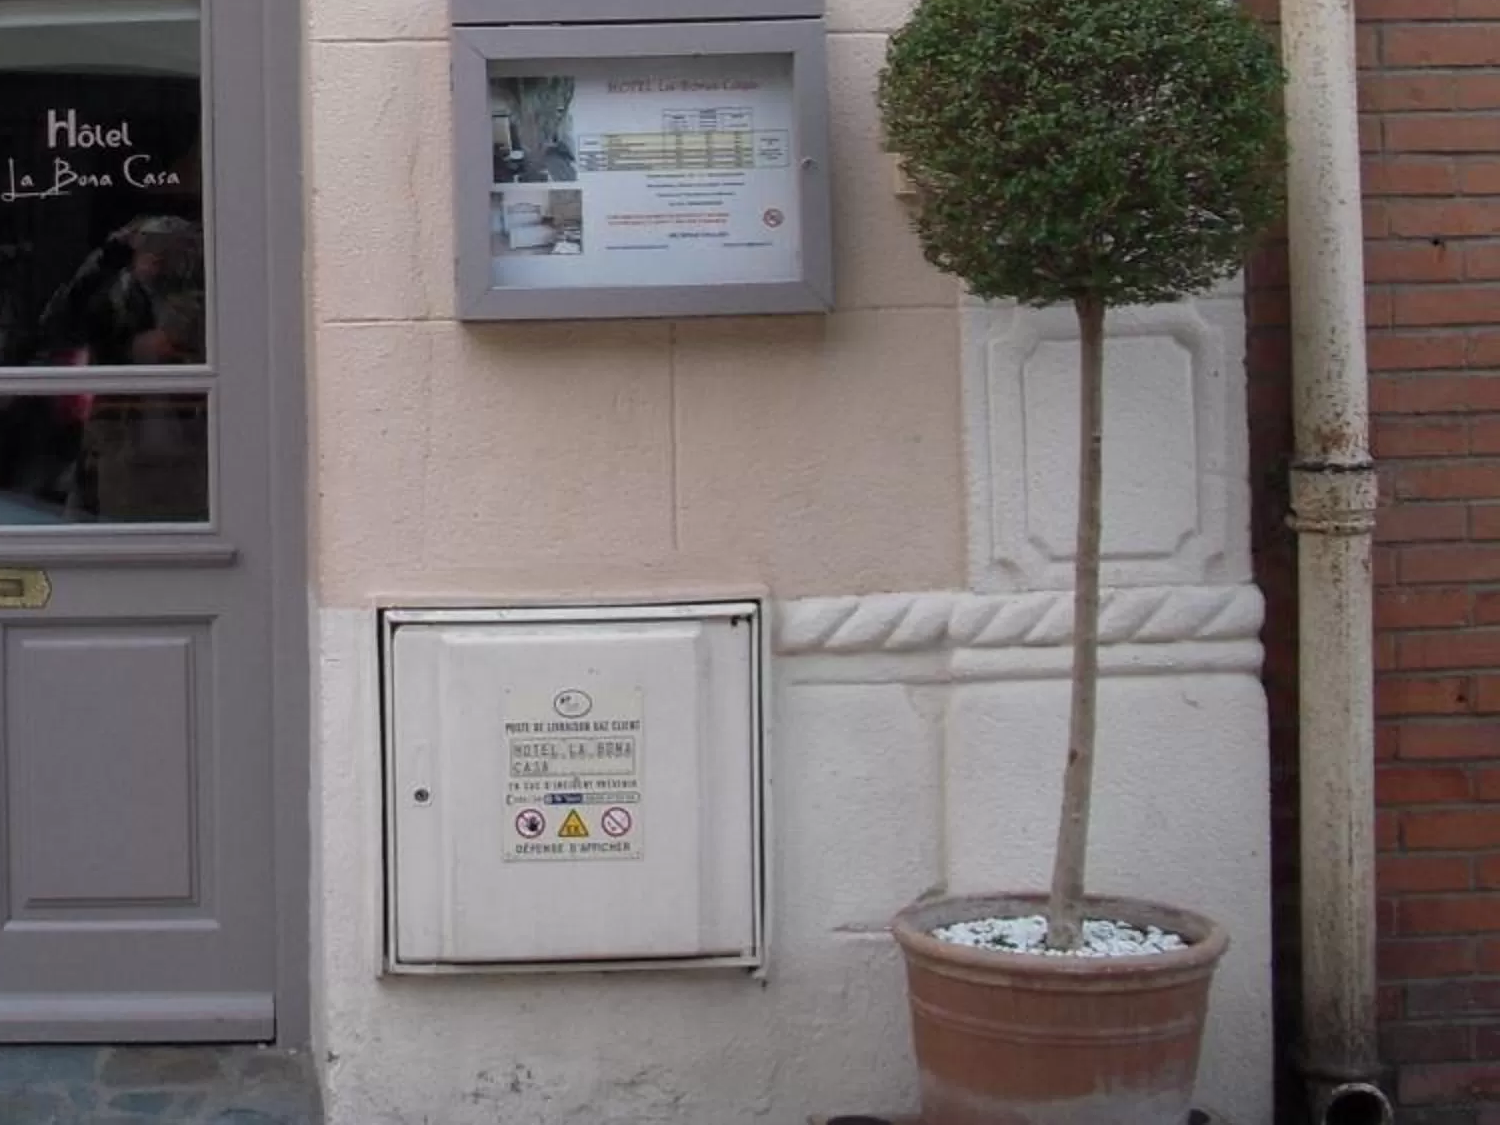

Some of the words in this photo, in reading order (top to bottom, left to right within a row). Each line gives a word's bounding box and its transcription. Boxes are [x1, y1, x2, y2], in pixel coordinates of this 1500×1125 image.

[47, 110, 132, 148] Hôtel
[1, 158, 41, 202] La
[42, 157, 113, 198] Bona
[123, 154, 180, 189] Casa
